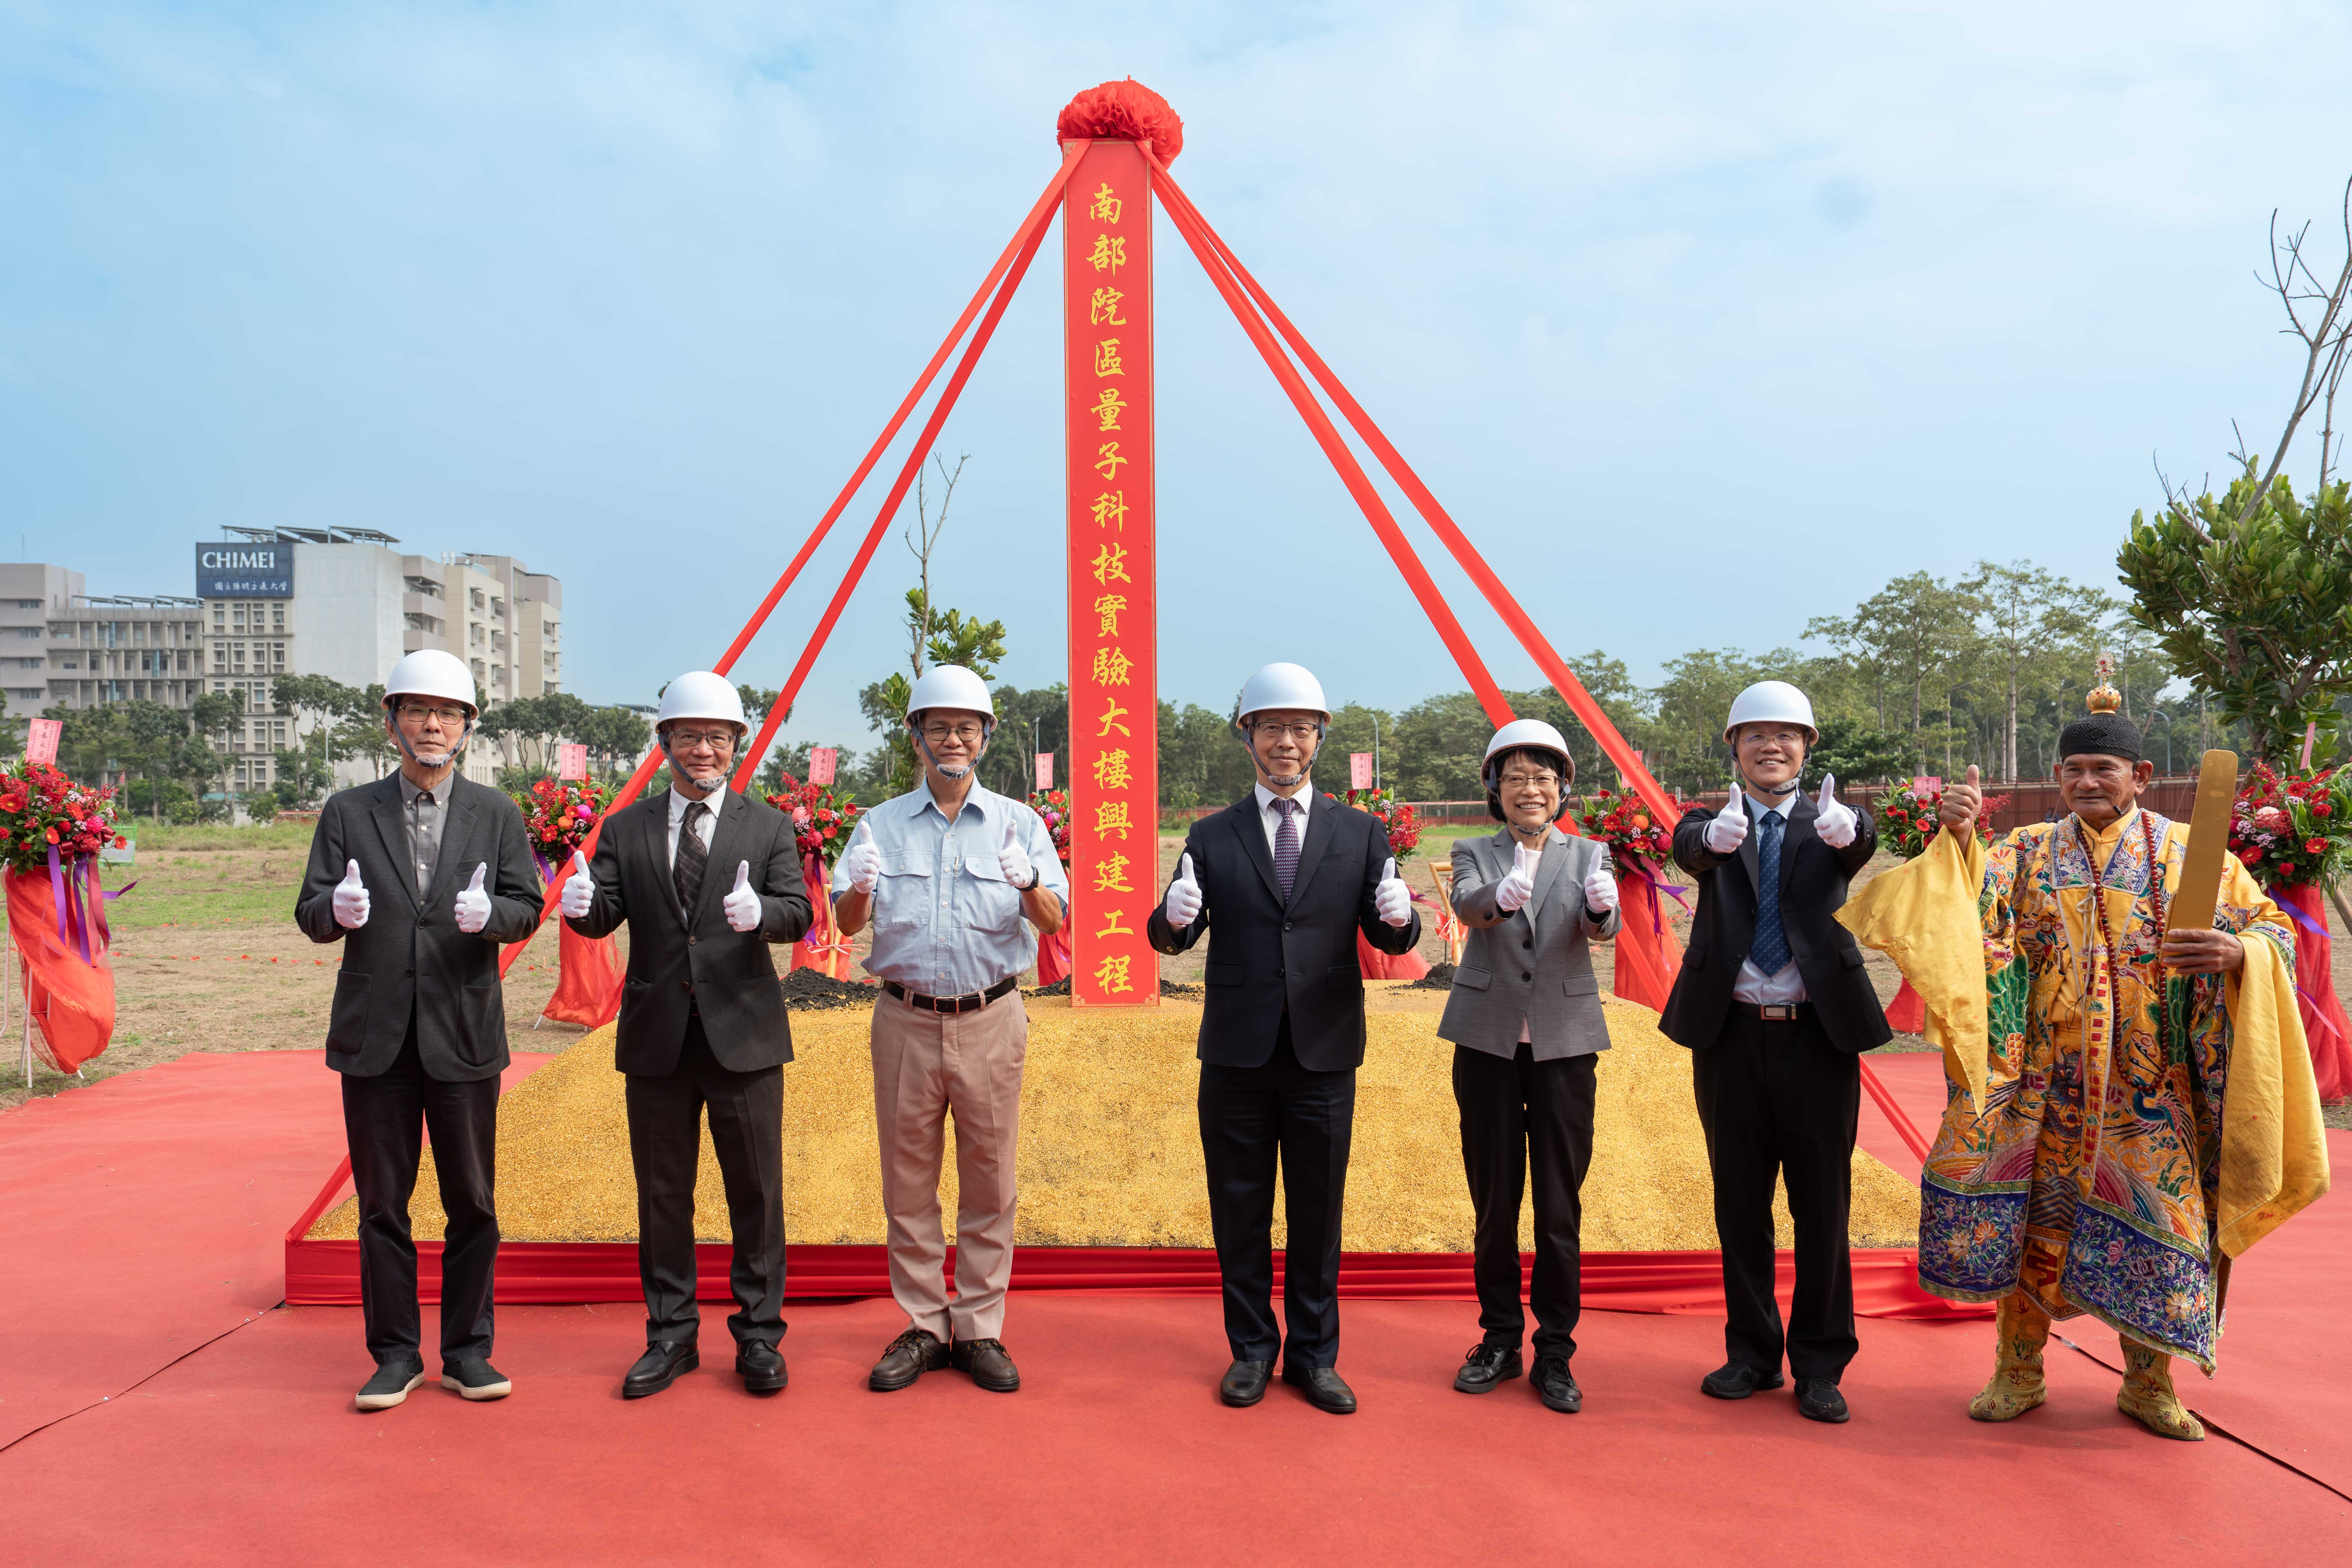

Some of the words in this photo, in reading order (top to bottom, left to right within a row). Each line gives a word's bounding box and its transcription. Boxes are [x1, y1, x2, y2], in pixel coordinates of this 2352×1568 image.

[202, 551, 274, 568] CHIMEI
[215, 581, 287, 591] 國立陽明交通大學
[1086, 183, 1135, 995] 南部院區量子科技實驗大樓興建工程
